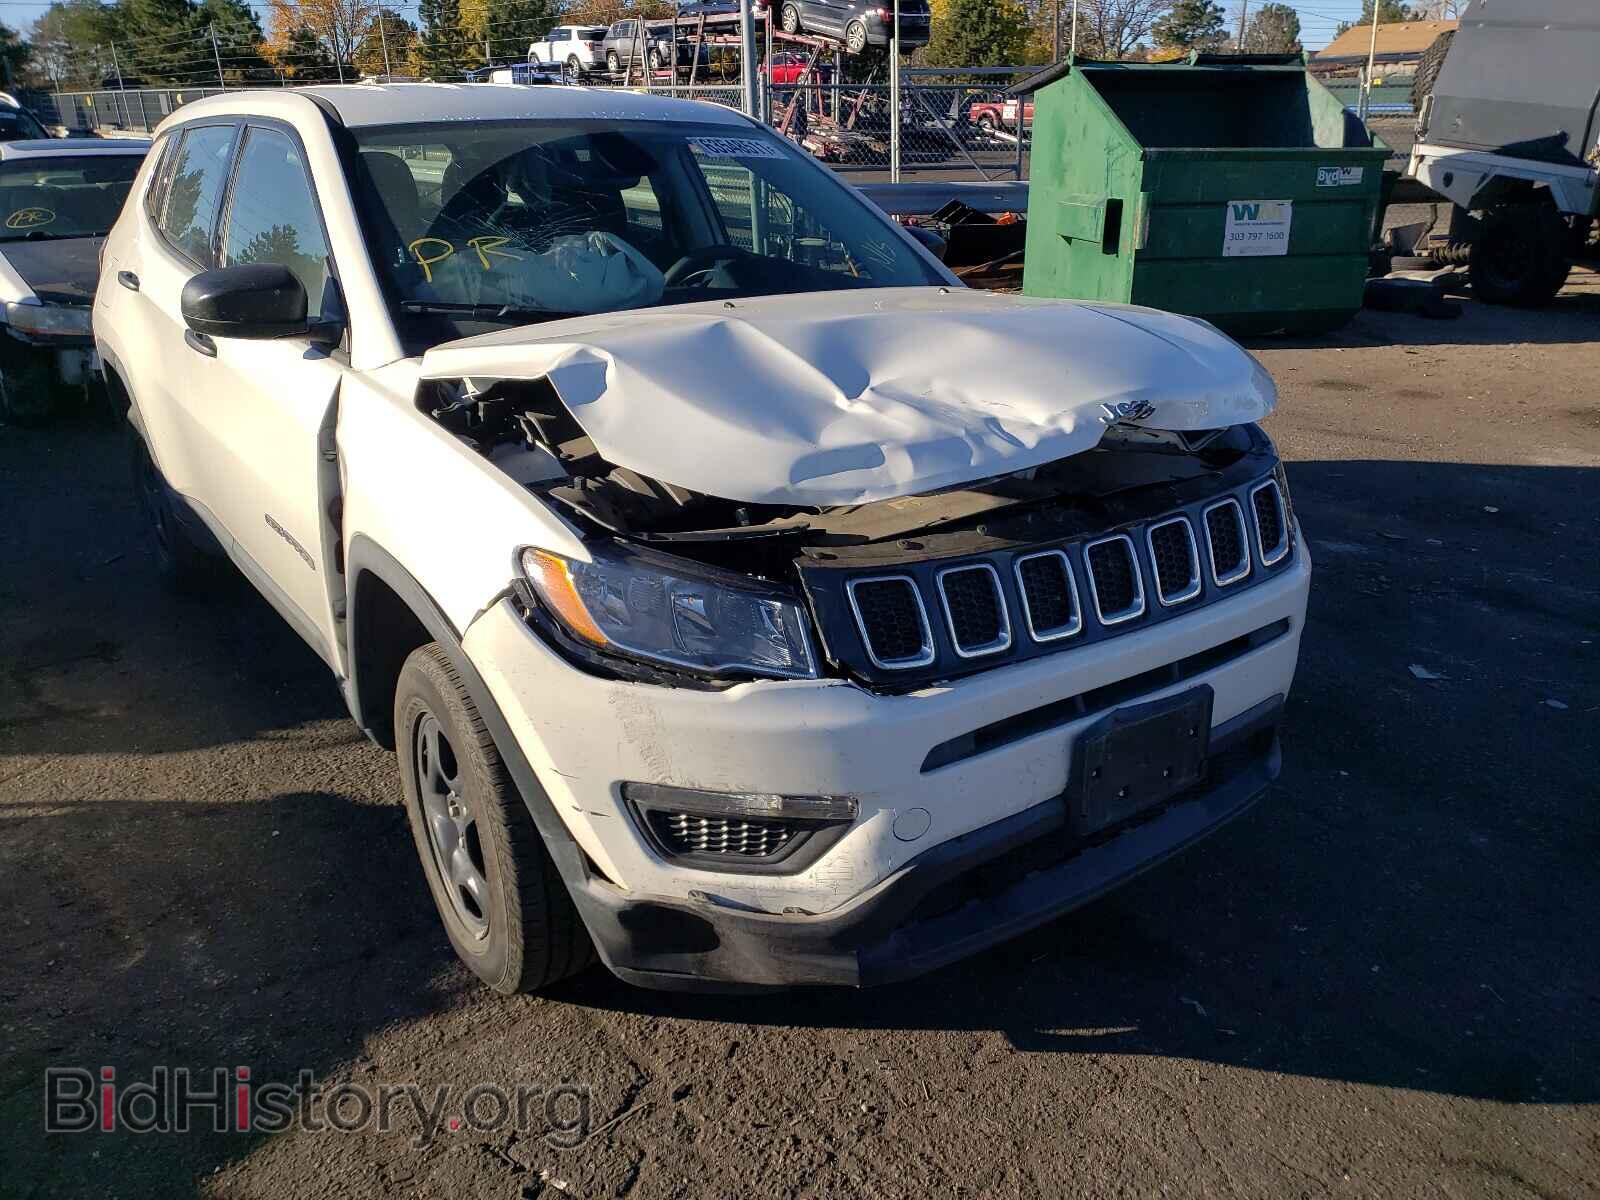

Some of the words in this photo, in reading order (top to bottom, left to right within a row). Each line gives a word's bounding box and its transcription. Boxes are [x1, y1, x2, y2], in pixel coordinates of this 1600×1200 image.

[1229, 232, 1245, 241] 303
[1248, 232, 1263, 241] 797
[1266, 231, 1285, 240] 1600
